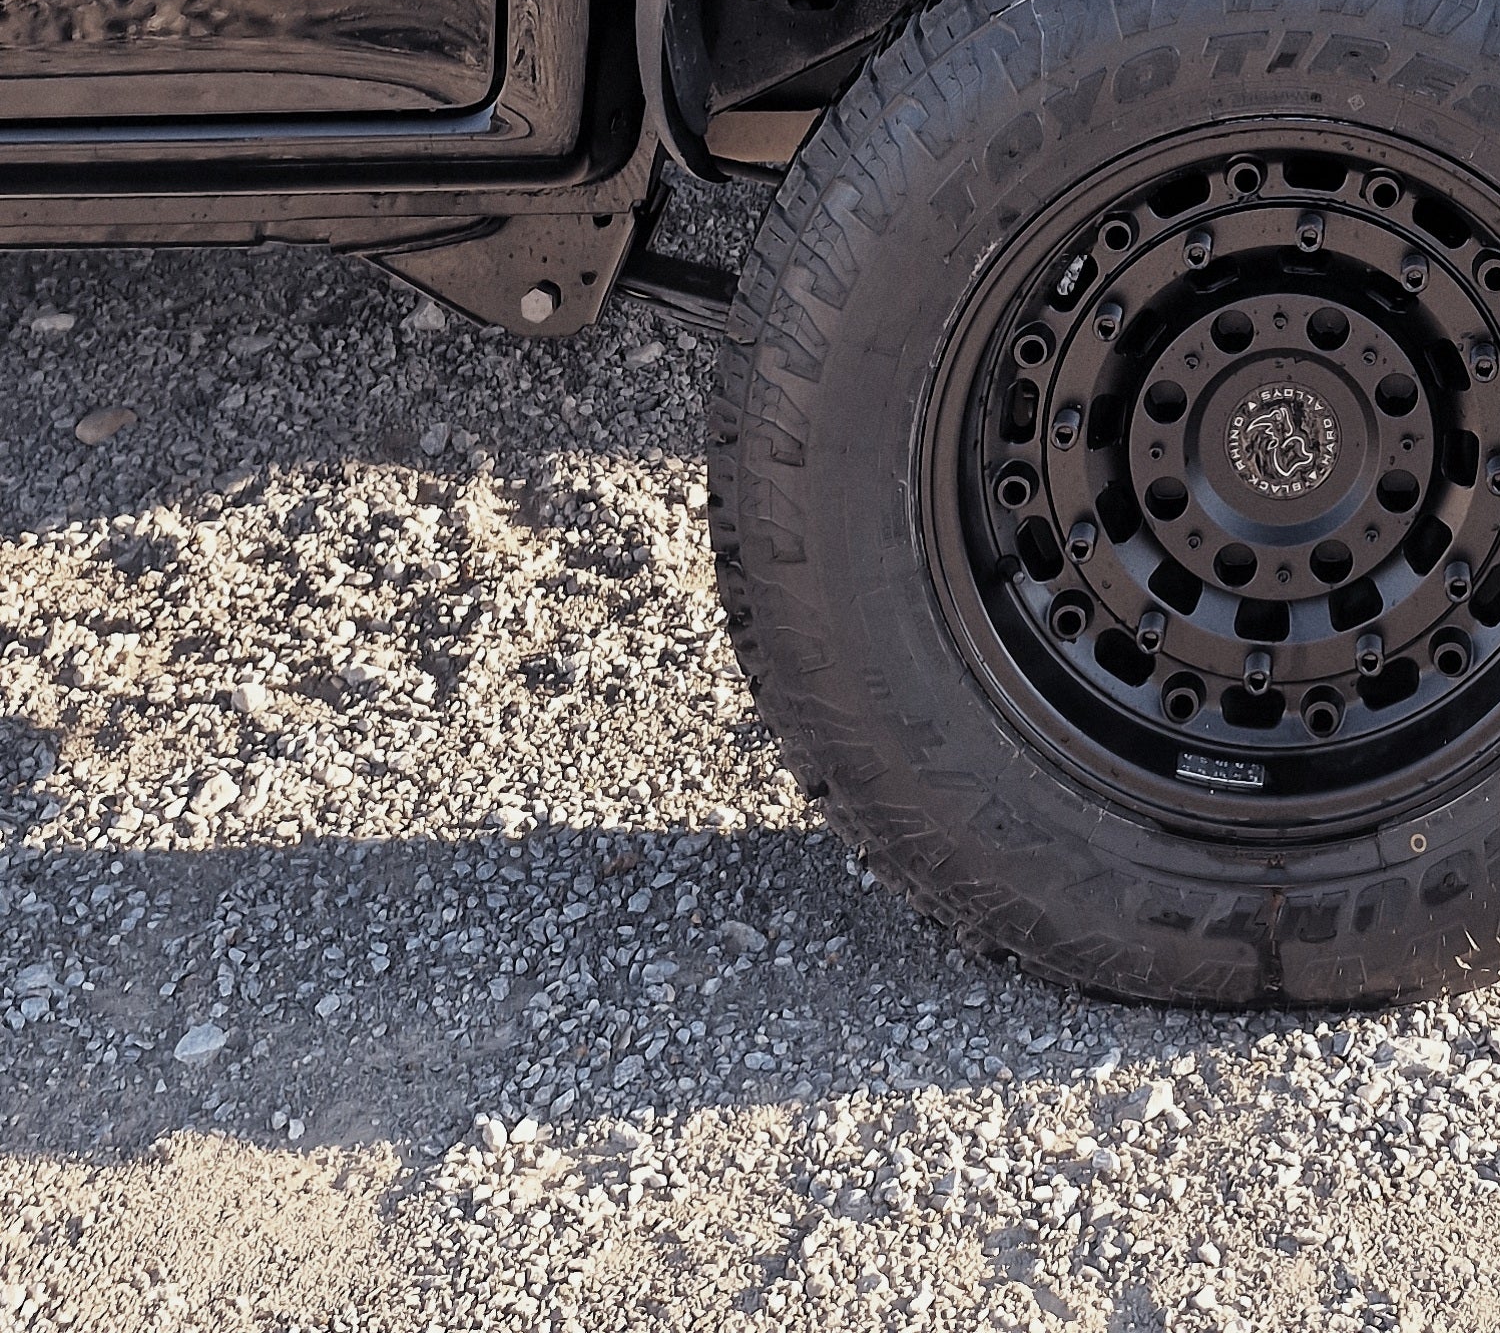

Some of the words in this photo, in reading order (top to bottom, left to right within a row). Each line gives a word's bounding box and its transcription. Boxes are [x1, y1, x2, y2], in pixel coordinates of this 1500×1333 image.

[927, 44, 1181, 235] TOYO
[1260, 388, 1324, 411] ALLOYS
[1230, 416, 1246, 471] RHINO
[1322, 418, 1337, 465] HARD
[1248, 474, 1302, 493] BLACK
